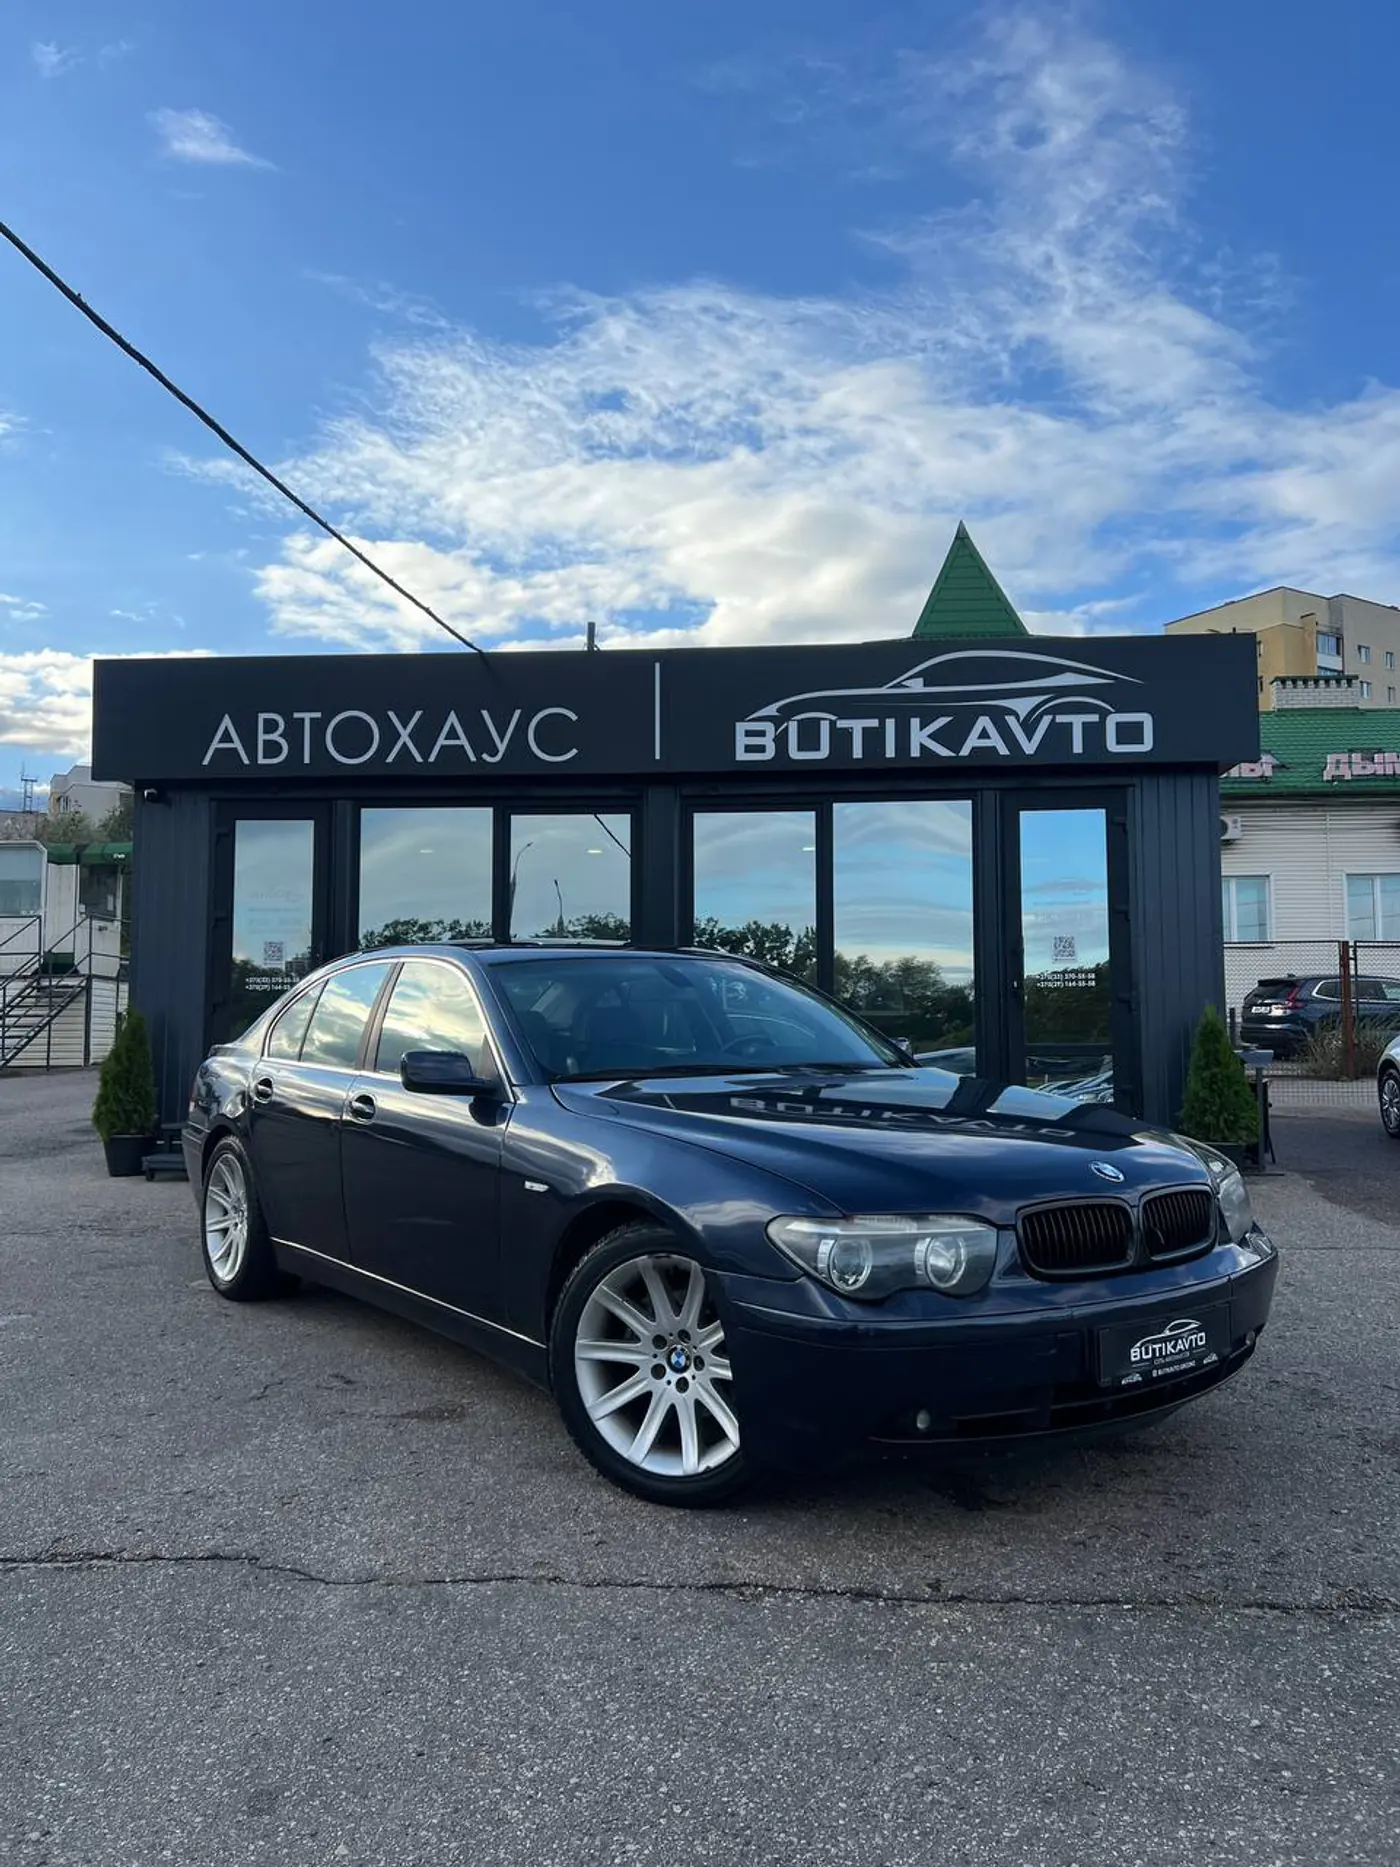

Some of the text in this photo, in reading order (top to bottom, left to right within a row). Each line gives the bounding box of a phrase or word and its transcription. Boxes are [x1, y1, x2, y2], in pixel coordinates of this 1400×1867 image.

[201, 706, 579, 766] АВТОХАУС
[735, 711, 1154, 762] BUTIKAVTO
[1130, 1332, 1206, 1362] BUTIKAVTO
